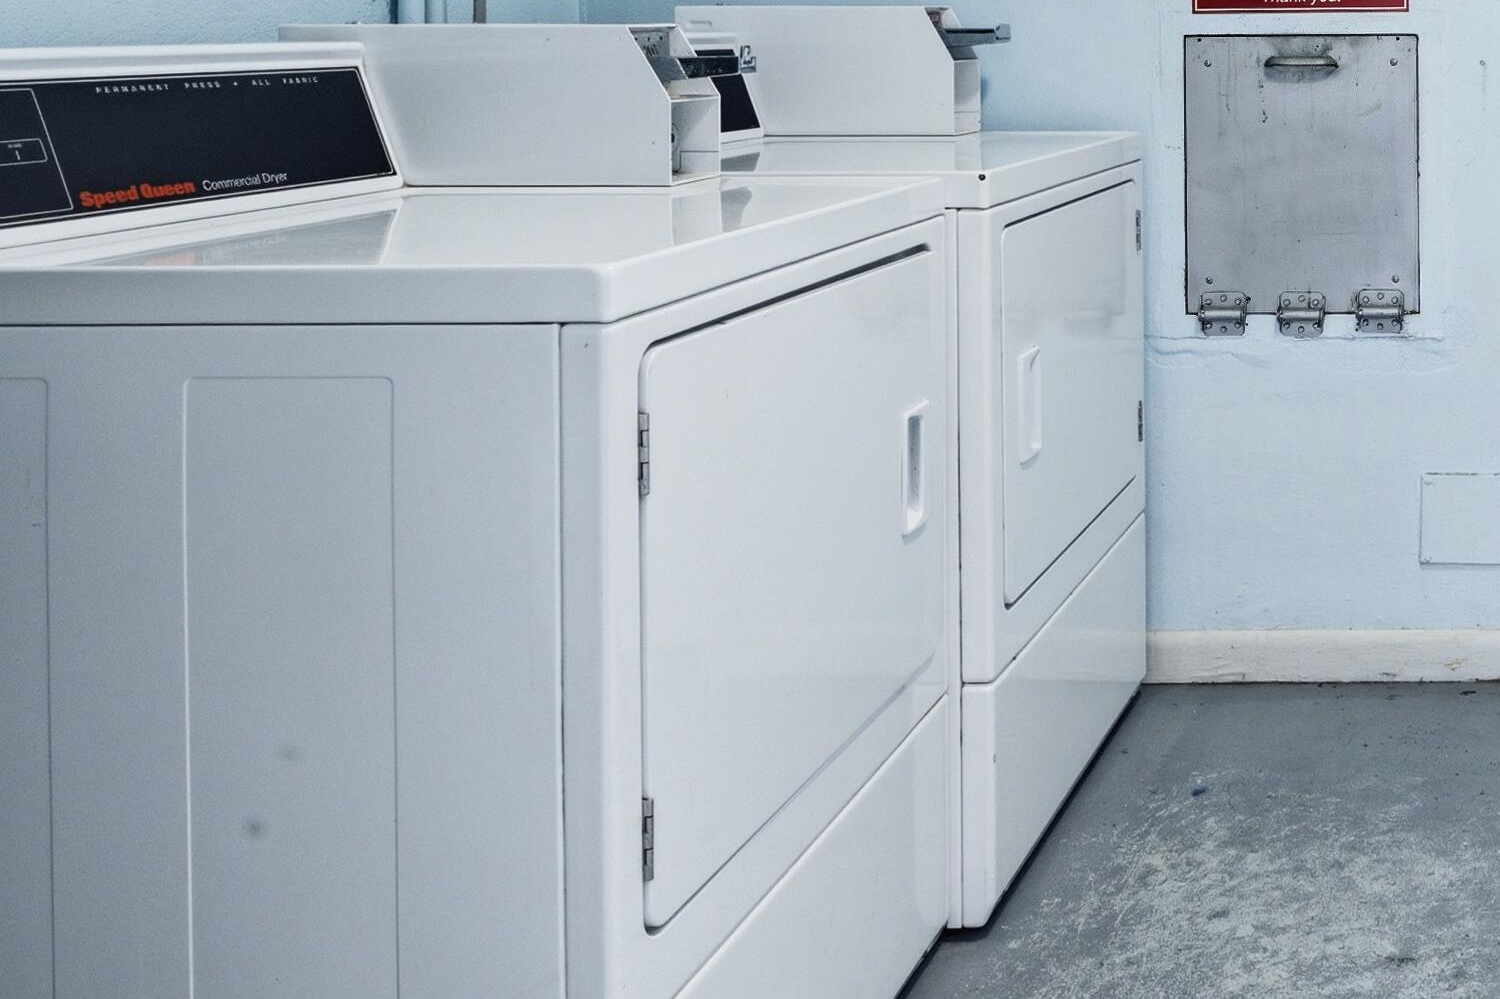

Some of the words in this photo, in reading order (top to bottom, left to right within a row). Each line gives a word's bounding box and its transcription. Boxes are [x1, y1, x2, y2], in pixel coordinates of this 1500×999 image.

[95, 84, 169, 94] PERMANENT
[184, 81, 221, 89] PRESS
[283, 76, 319, 84] FABRIC
[79, 184, 139, 208] Speed
[139, 180, 196, 199] Queen
[202, 174, 261, 191] Commercial
[262, 171, 289, 185] Dryer
